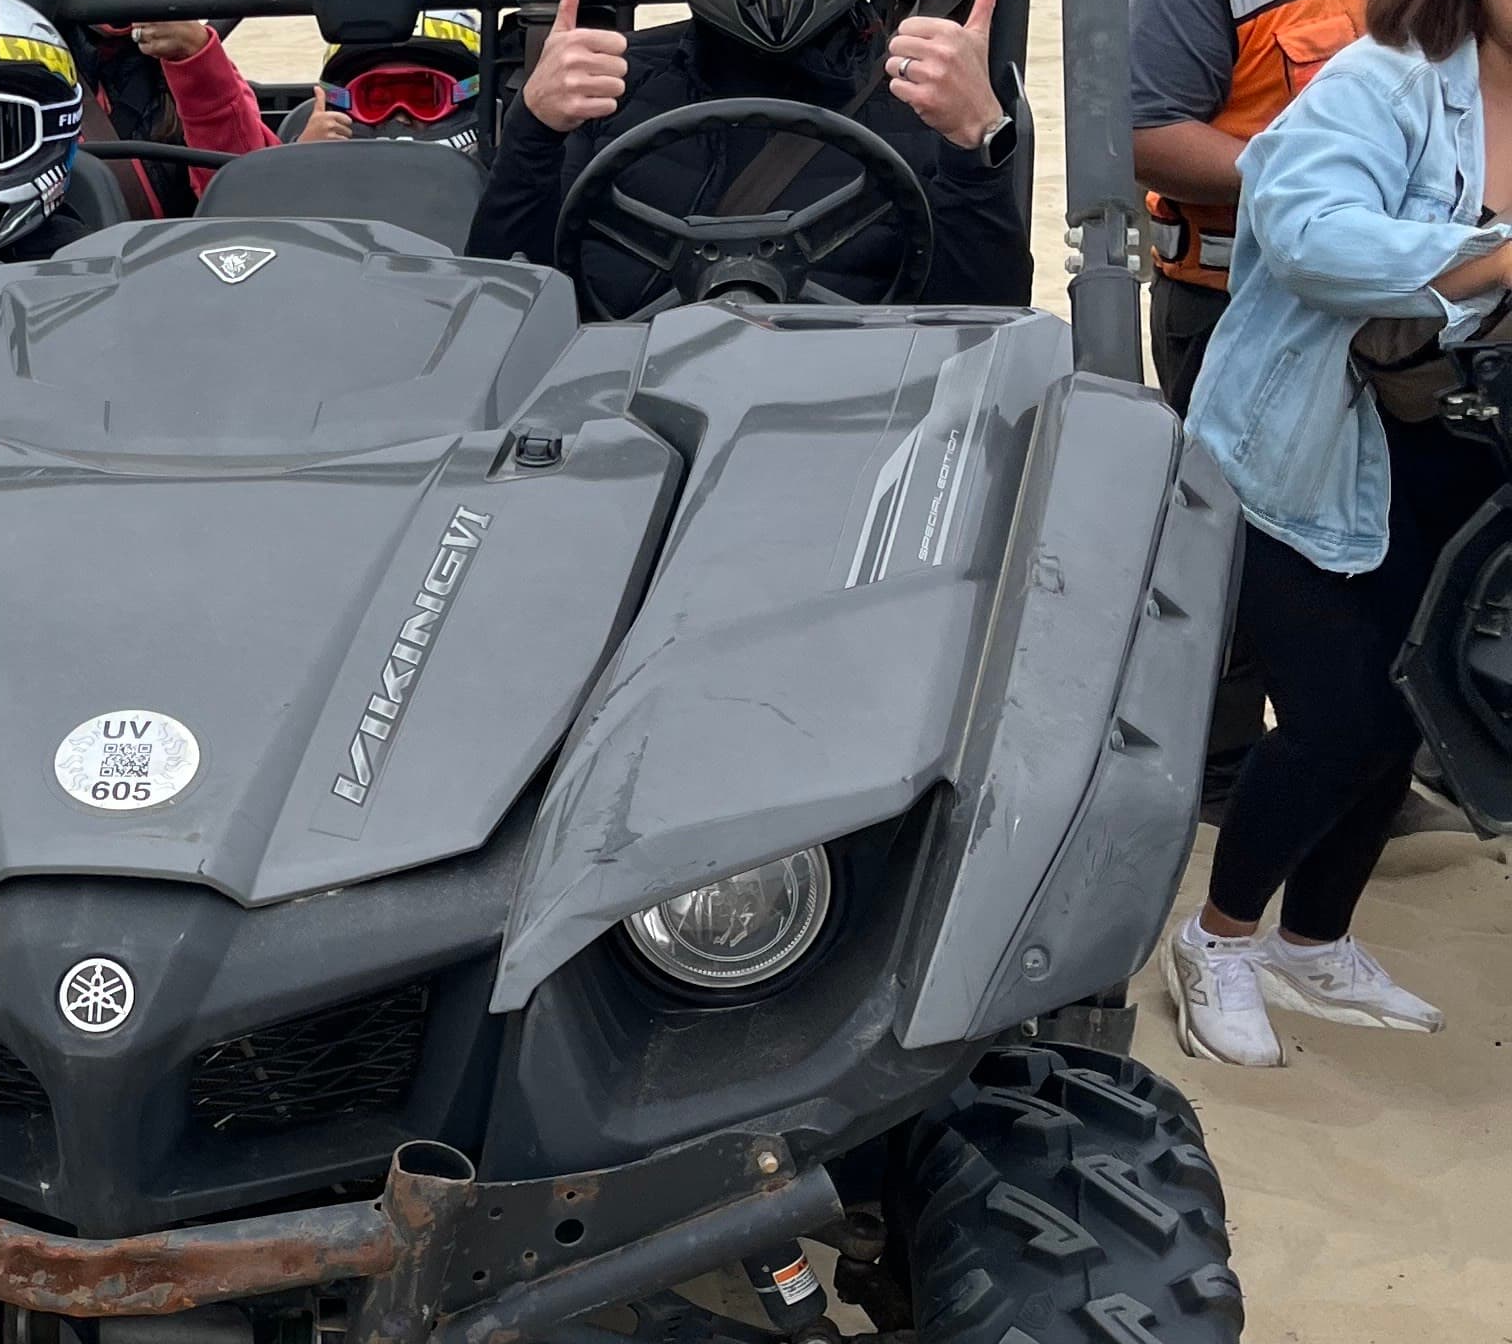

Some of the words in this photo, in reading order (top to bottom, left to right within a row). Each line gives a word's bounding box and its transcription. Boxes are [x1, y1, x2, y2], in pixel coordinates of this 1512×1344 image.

[918, 491, 943, 562] SPECIAL
[937, 429, 959, 489] EDITION
[103, 720, 152, 739] UV
[91, 781, 152, 801] 605
